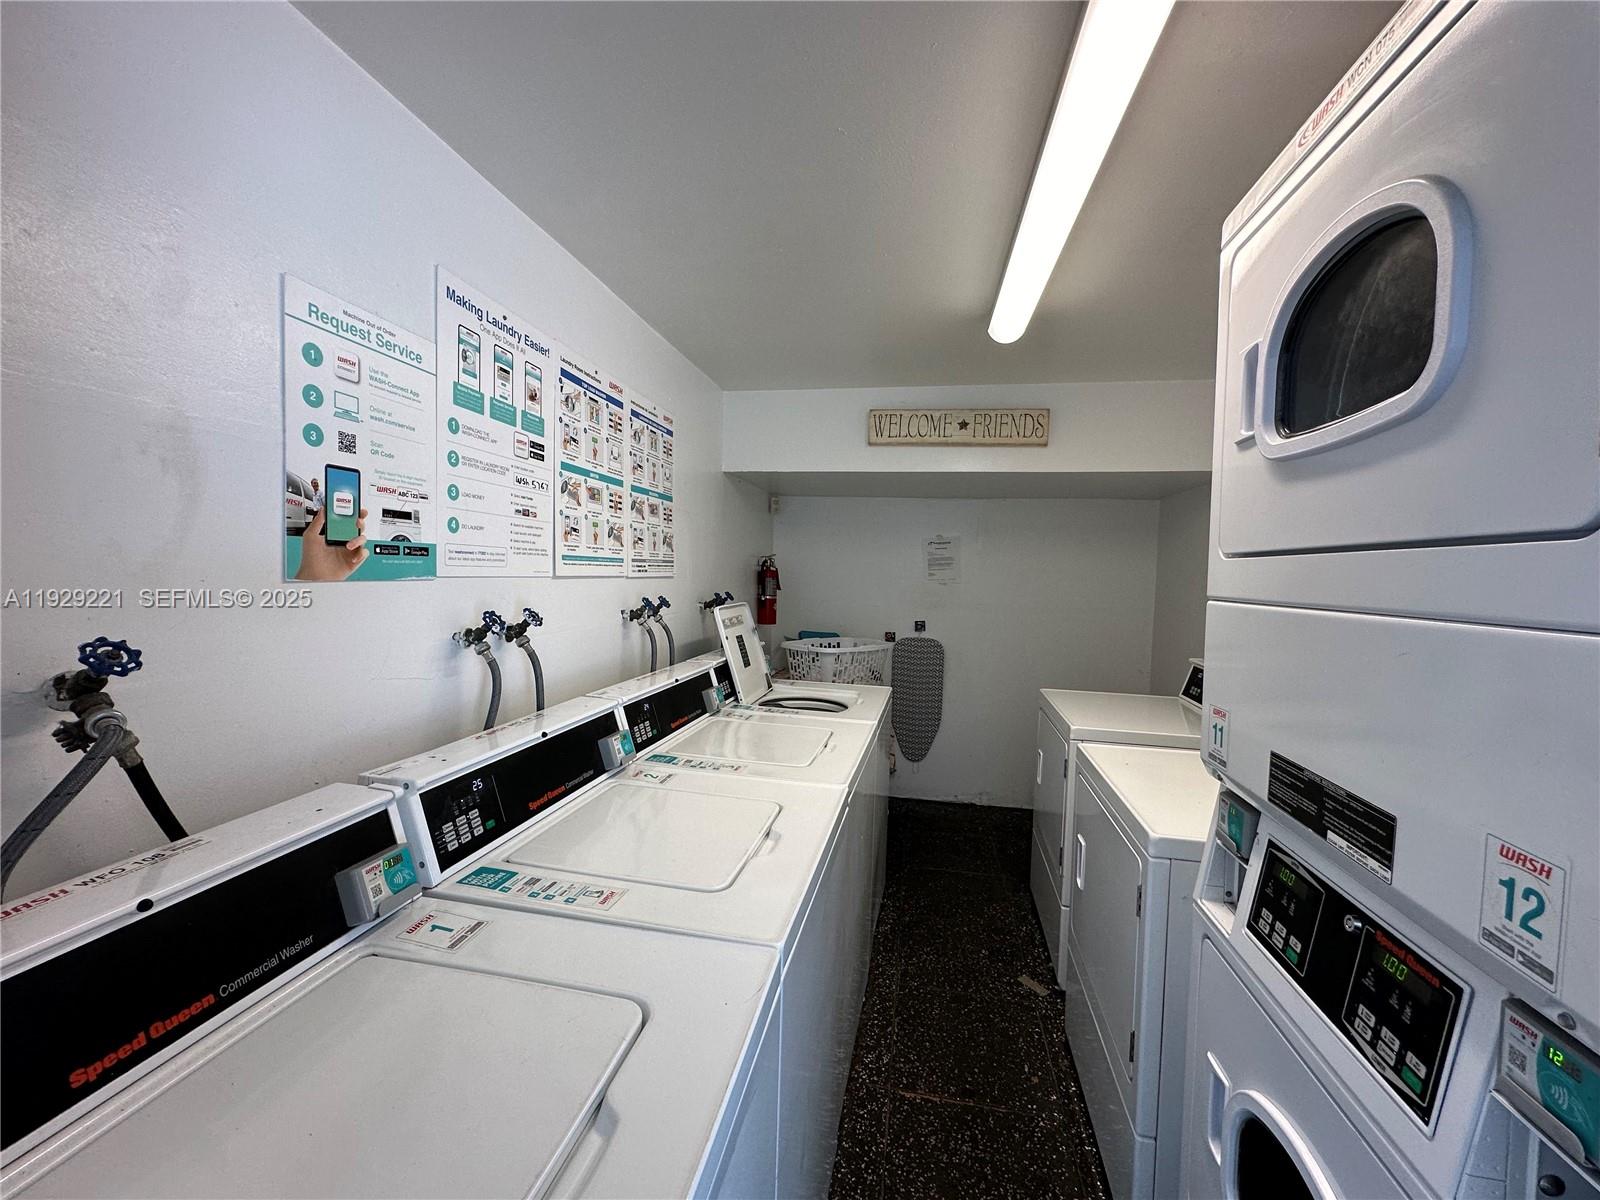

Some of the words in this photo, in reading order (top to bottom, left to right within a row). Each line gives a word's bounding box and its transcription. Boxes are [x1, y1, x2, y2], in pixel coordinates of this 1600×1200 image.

[1311, 83, 1345, 132] WASH
[342, 309, 366, 324] Machine
[366, 319, 376, 329] Out
[382, 327, 396, 338] Order
[446, 285, 483, 322] Making
[486, 310, 522, 344] Laundry
[524, 333, 550, 359] Easier!
[479, 323, 491, 335] One
[491, 331, 502, 342] App
[308, 302, 372, 343] Request
[375, 333, 423, 364] Service
[309, 350, 316, 361] 1
[337, 355, 356, 367] WASH
[309, 391, 317, 401] 2
[310, 431, 317, 441] 3
[872, 413, 953, 438] WELCOME
[972, 413, 1046, 438] FRIENDS
[370, 448, 380, 456] QR
[380, 450, 395, 459] Code
[376, 485, 397, 495] WASH
[1212, 722, 1224, 749] 11
[472, 778, 483, 791] 25
[528, 793, 548, 811] Speed
[547, 785, 566, 799] Queen
[1498, 843, 1553, 880] WASH
[72, 867, 126, 887] WFO
[598, 890, 616, 905] WASH
[1498, 877, 1546, 941] 12
[405, 914, 434, 934] WASH
[429, 924, 455, 933] 1
[1375, 929, 1406, 960] Speed
[1406, 953, 1440, 989] Queen
[69, 1030, 147, 1089] Speed
[149, 993, 215, 1040] Queen
[218, 954, 280, 999] Commercial
[279, 934, 314, 961] Washer
[1509, 1015, 1538, 1041] WASH
[1548, 1046, 1564, 1067] 12
